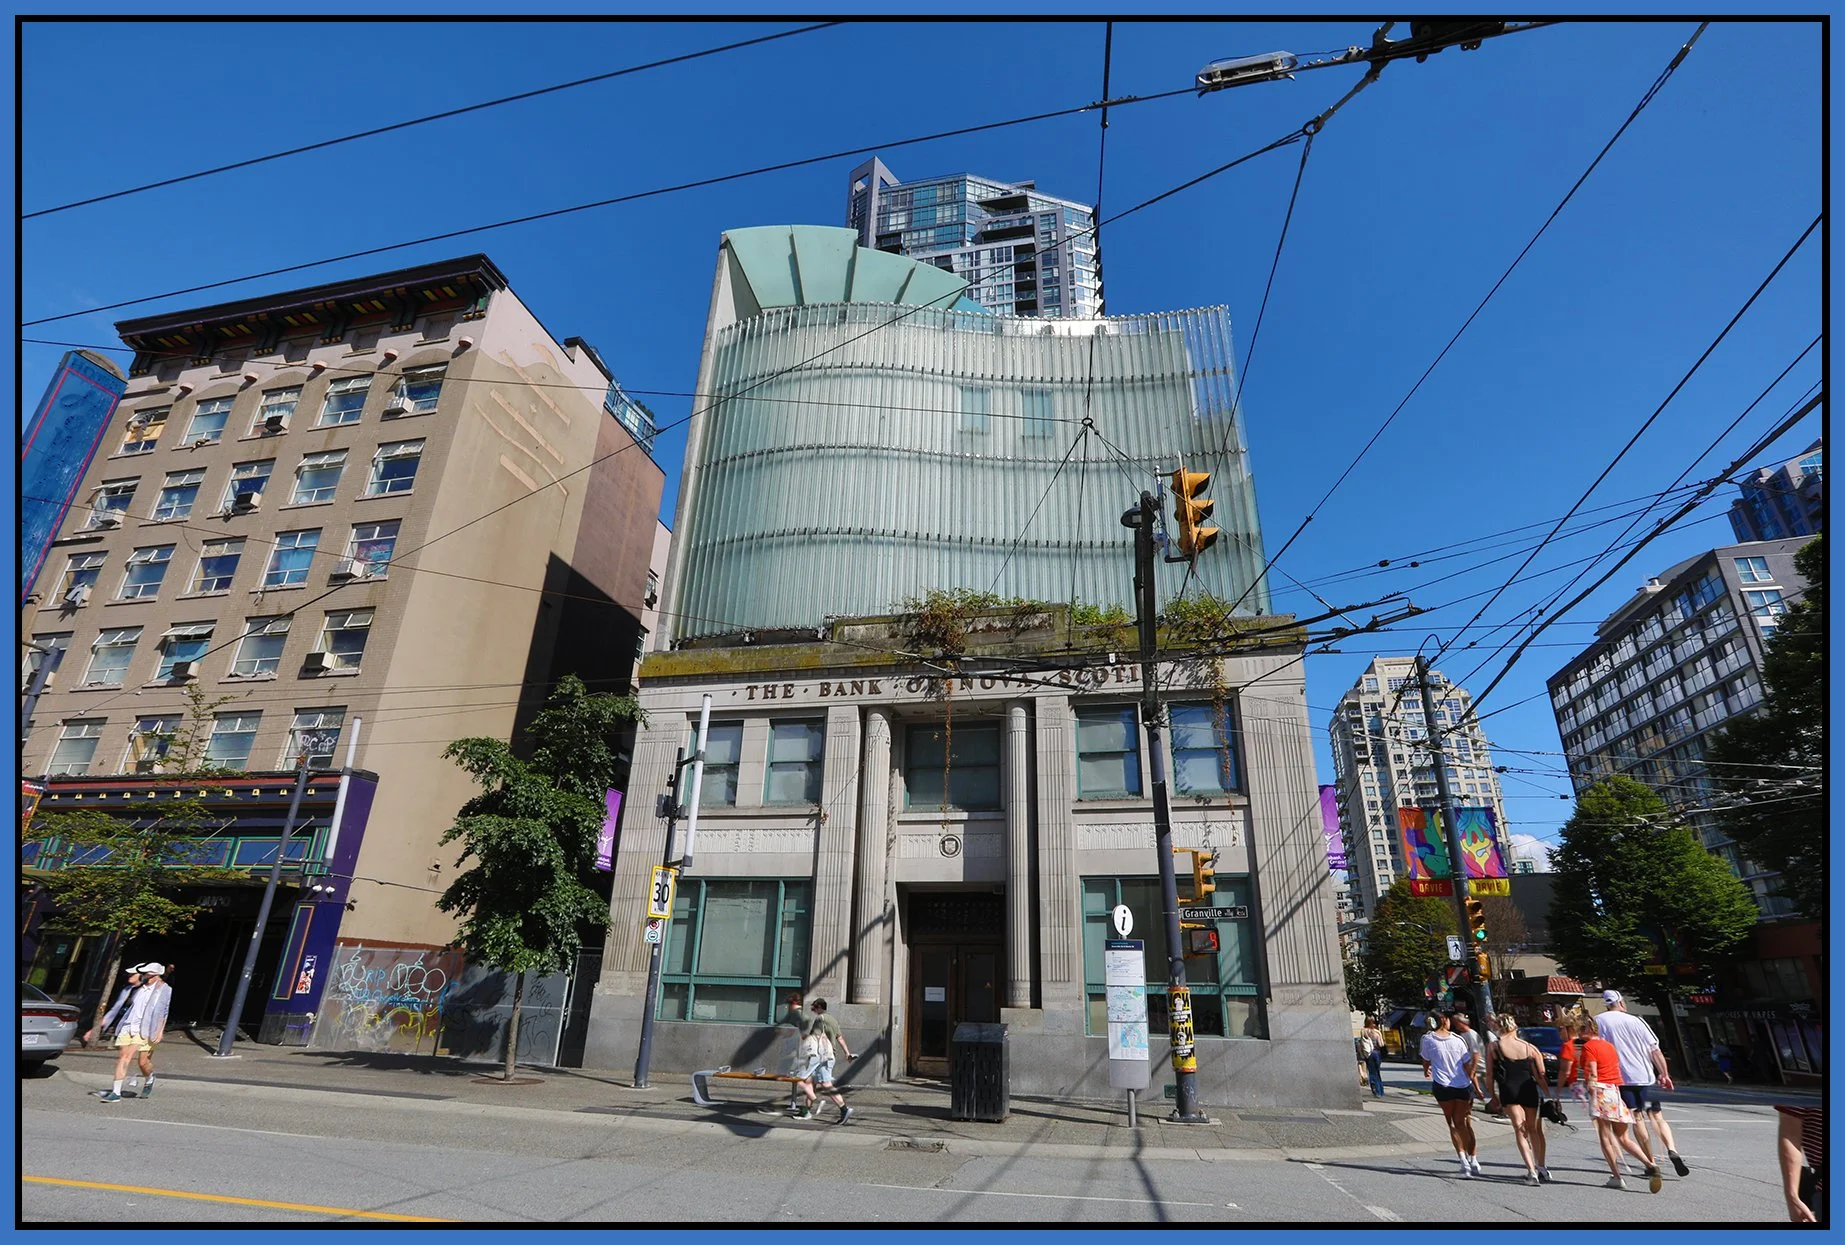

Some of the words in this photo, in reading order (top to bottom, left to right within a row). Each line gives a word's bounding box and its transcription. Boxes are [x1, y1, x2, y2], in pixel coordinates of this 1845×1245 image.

[746, 684, 795, 700] THE
[819, 679, 882, 697] BANK
[1059, 664, 1141, 685] SCOTI
[1419, 883, 1443, 893] DAVIE
[1476, 881, 1501, 892] DAVIE
[653, 882, 669, 904] 30
[1185, 908, 1222, 918] Granville
